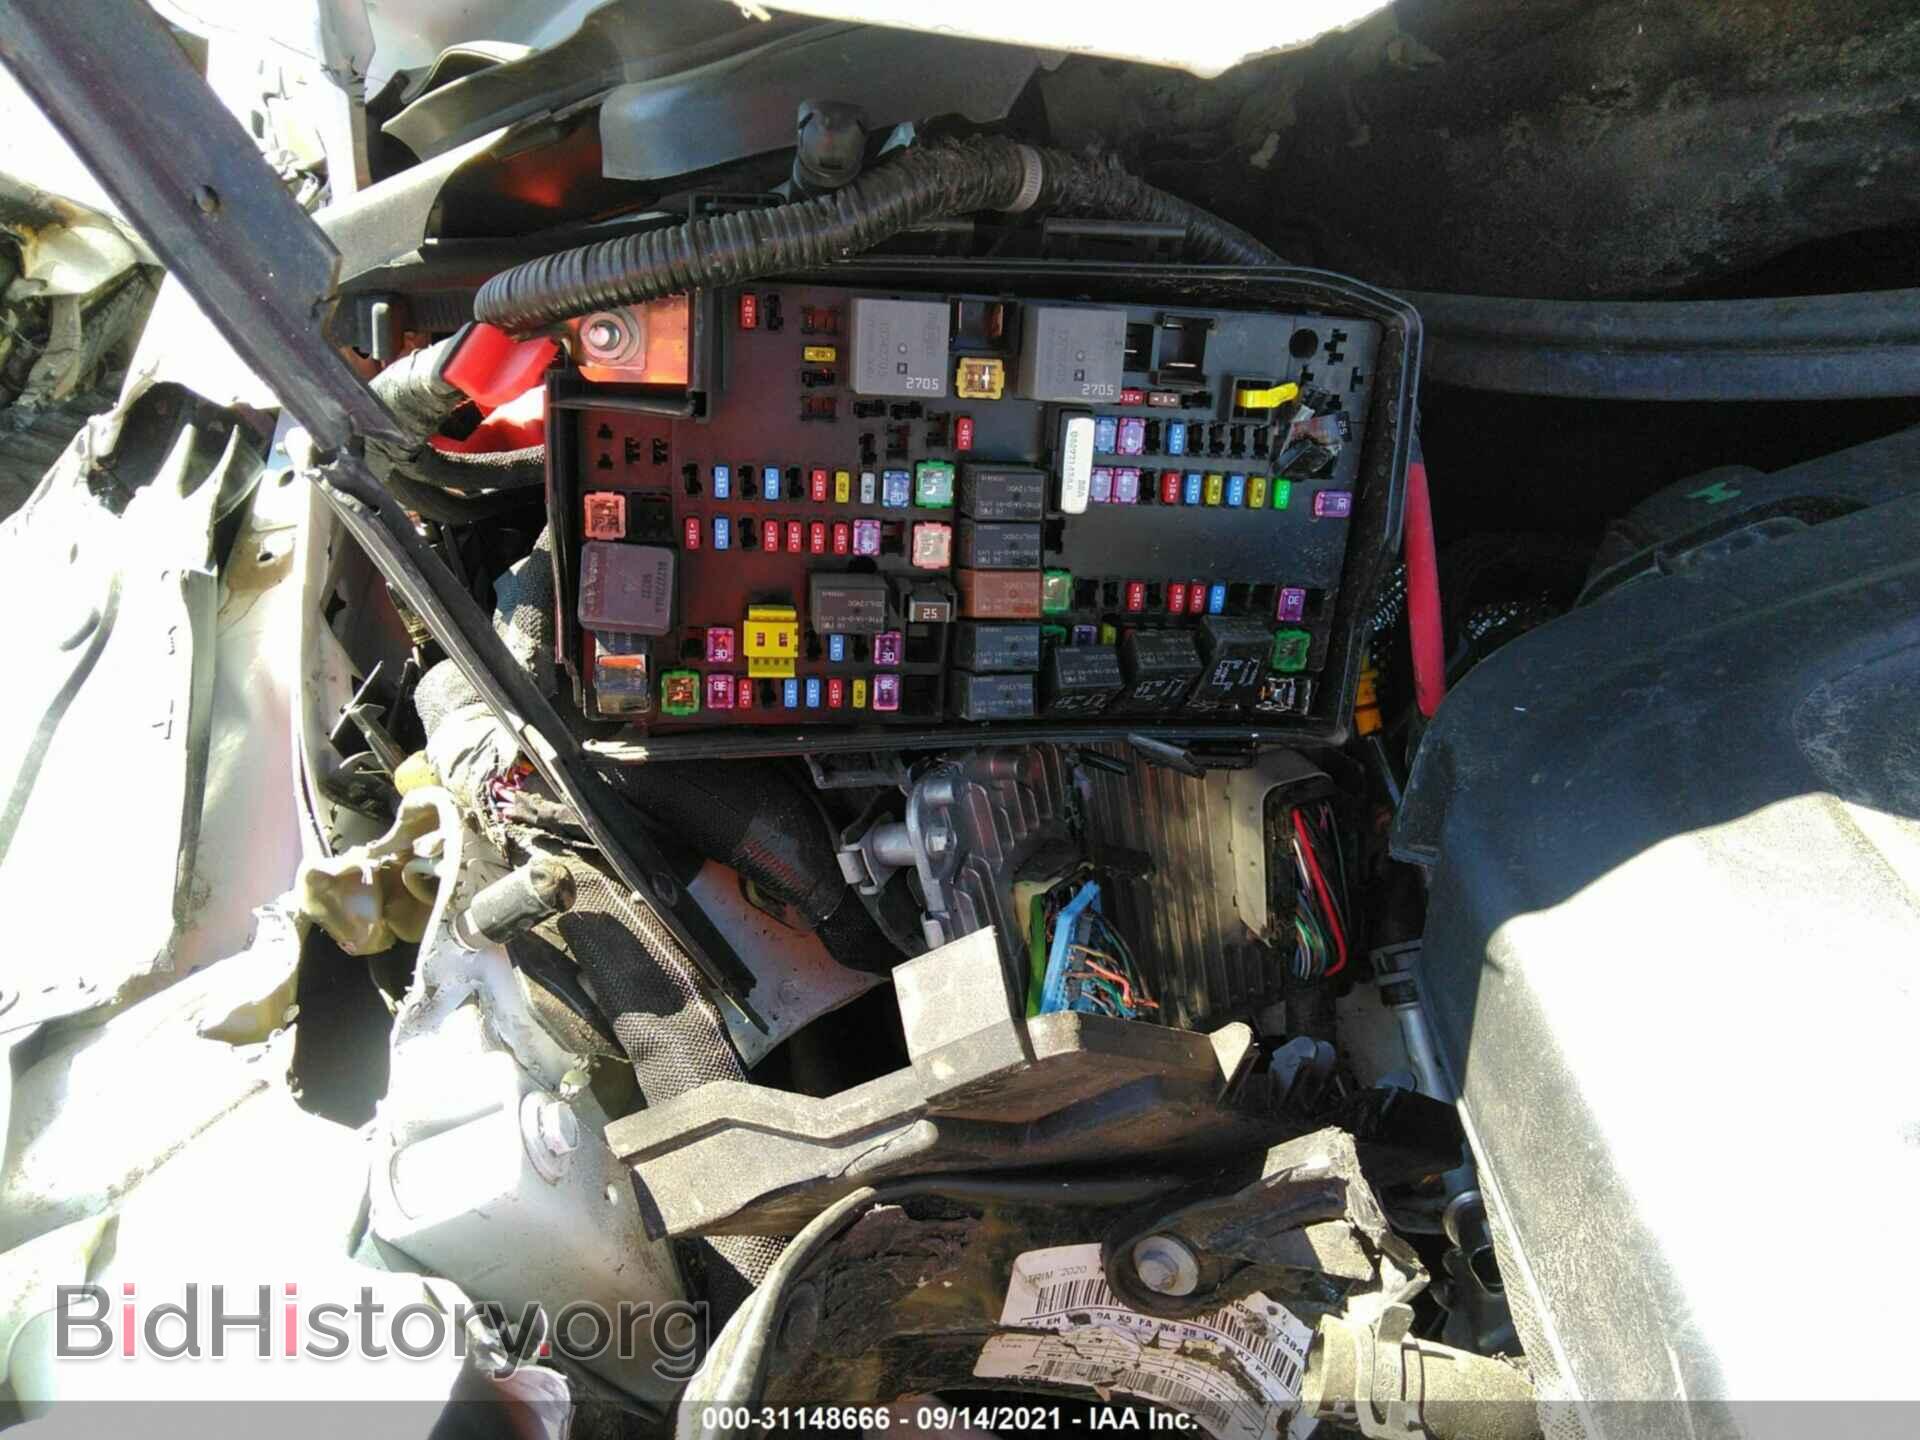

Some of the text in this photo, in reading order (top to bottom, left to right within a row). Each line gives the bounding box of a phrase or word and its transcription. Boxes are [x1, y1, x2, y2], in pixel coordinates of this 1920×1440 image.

[905, 377, 939, 390] 2705
[1081, 384, 1114, 396] 2705
[923, 608, 937, 619] 25
[713, 648, 728, 660] 30
[881, 651, 895, 662] 30
